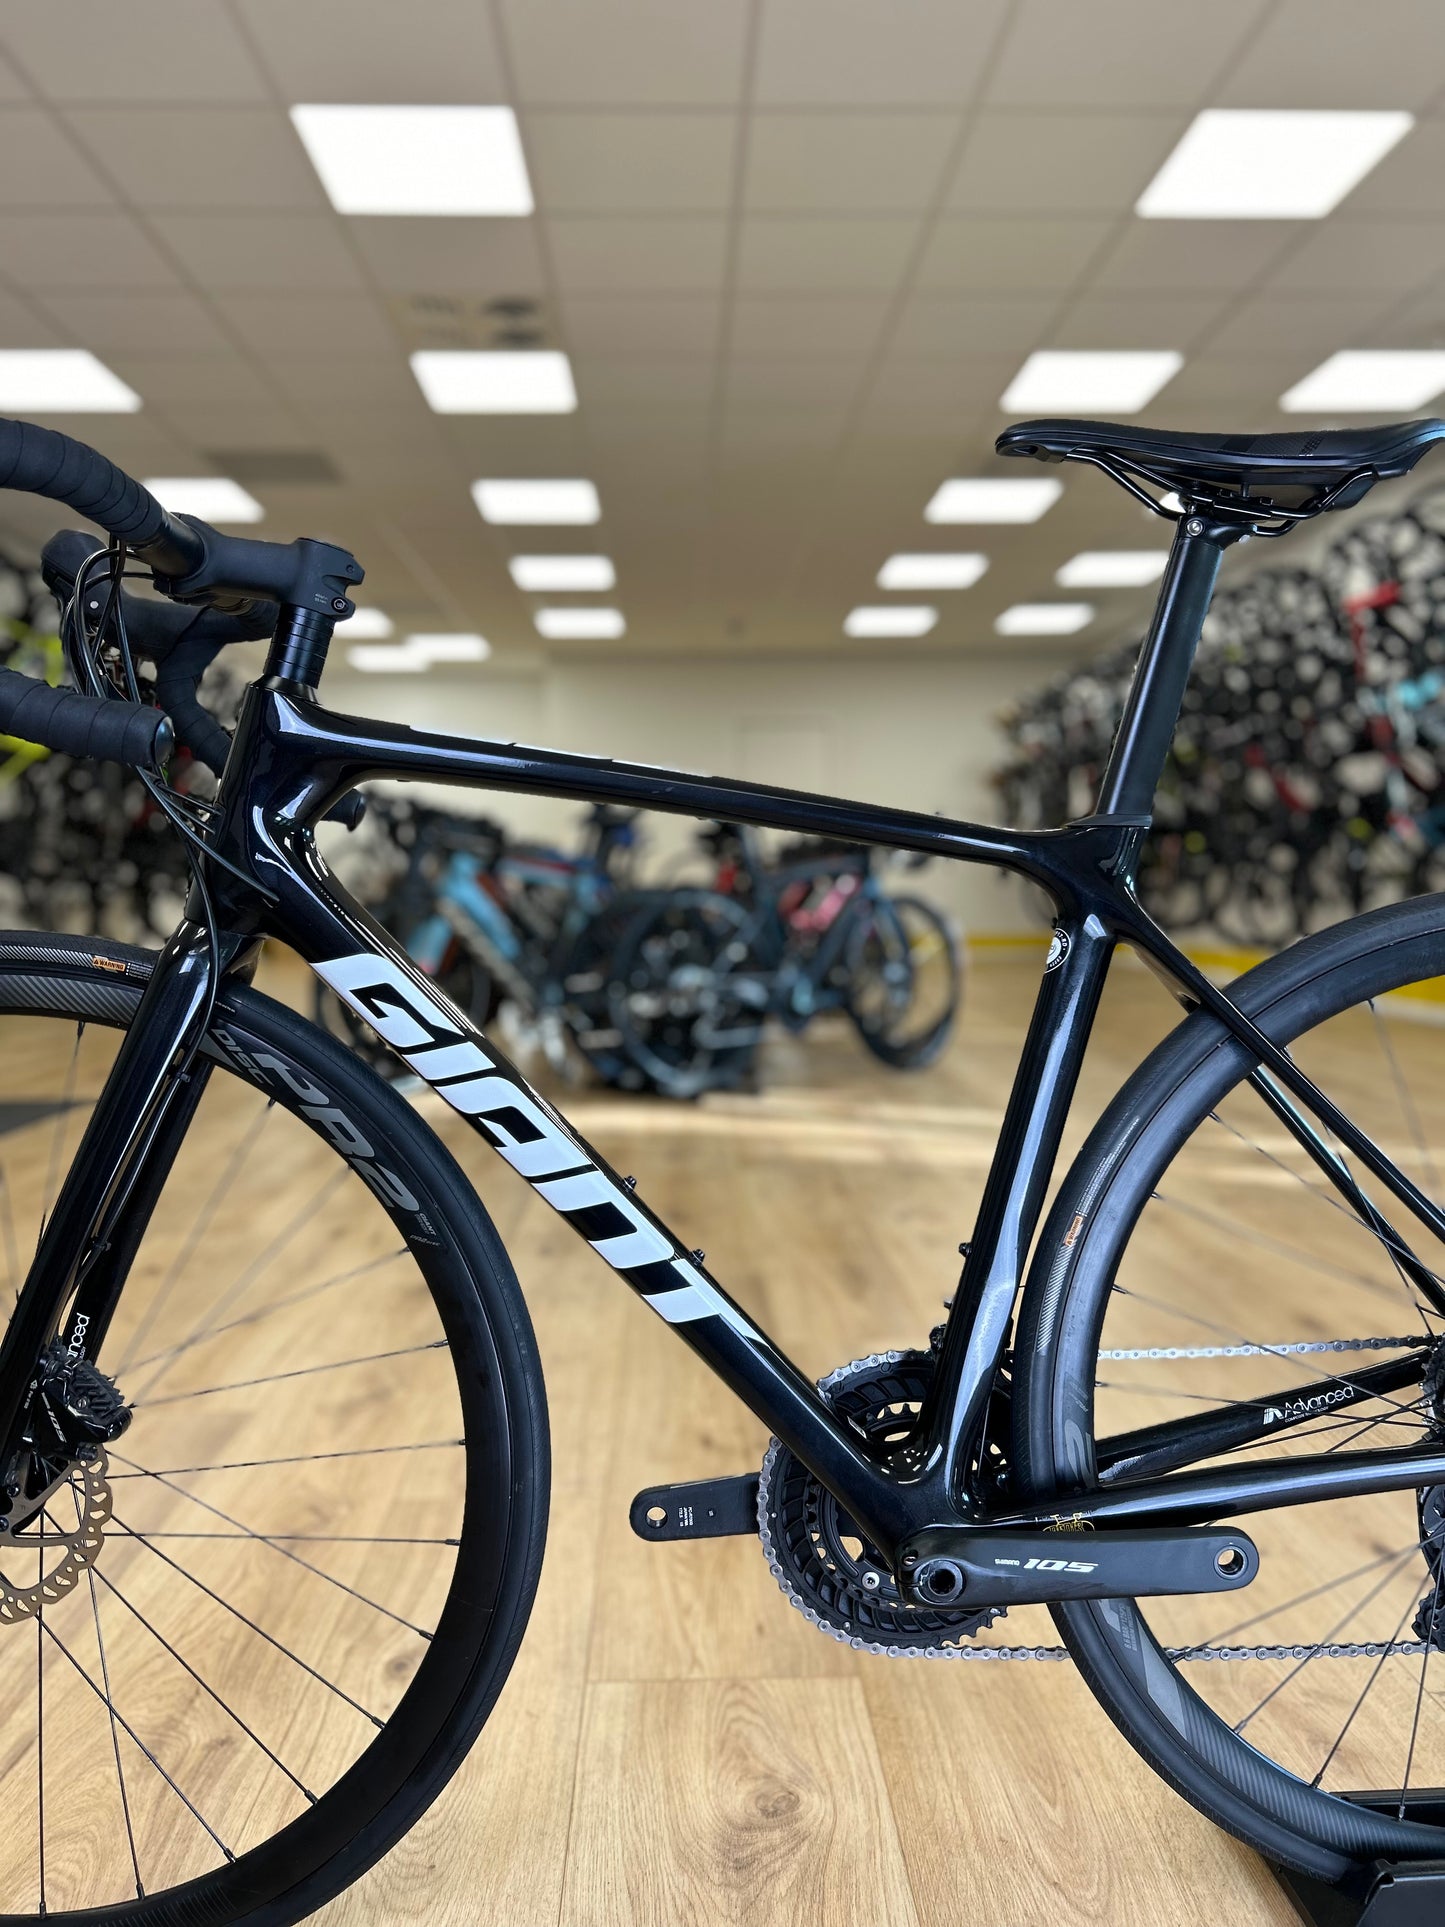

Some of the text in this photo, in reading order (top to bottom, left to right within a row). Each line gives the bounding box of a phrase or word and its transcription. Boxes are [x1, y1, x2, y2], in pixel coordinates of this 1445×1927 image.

[99, 960, 125, 971] WARNING
[211, 1028, 275, 1088] DISC
[251, 1053, 419, 1211] PR2
[309, 953, 770, 1348] GIANT
[420, 1213, 437, 1236] GIANT
[1284, 1385, 1354, 1418] Advanced
[47, 1410, 68, 1443] 105
[1023, 1558, 1099, 1573] 105
